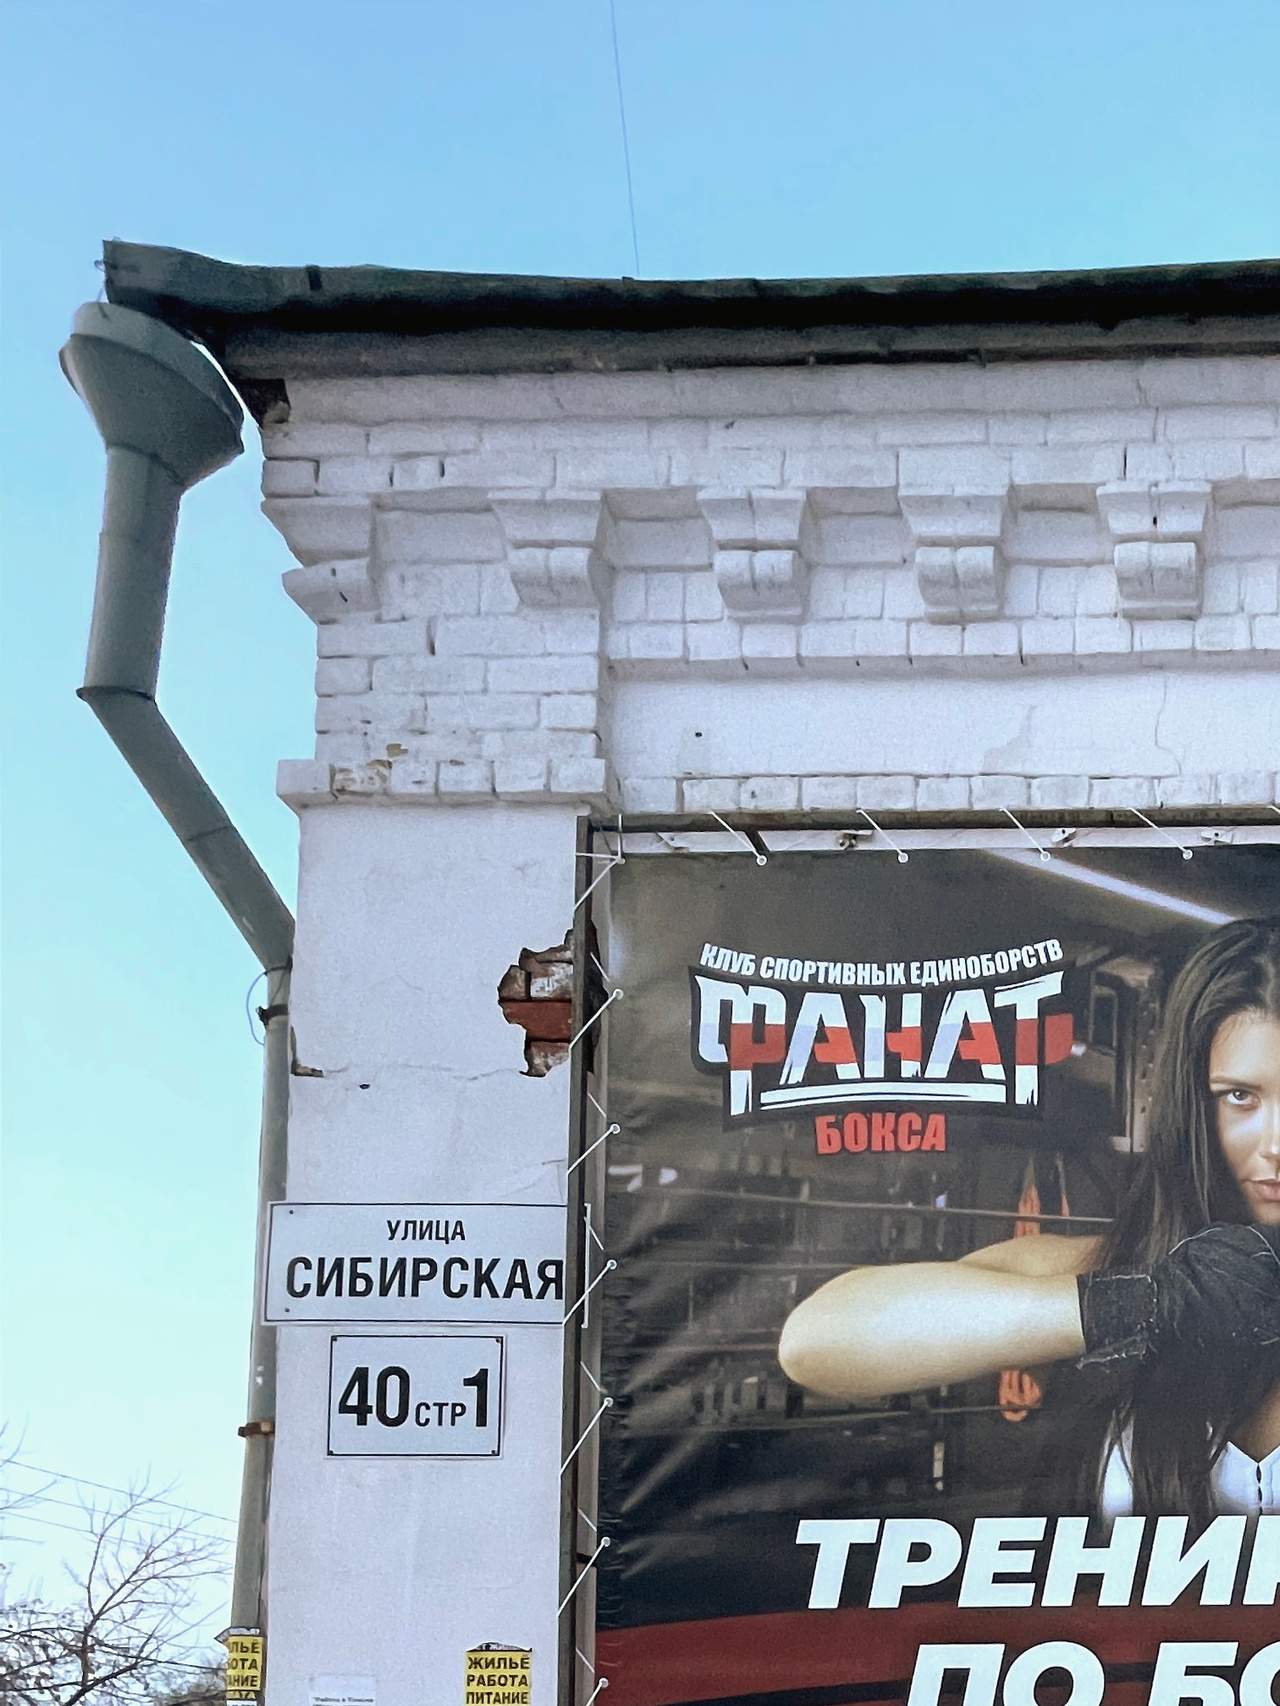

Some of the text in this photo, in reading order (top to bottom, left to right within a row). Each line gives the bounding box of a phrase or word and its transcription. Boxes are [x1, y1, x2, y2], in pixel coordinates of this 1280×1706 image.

[699, 938, 1064, 987] КЛУБ СПОРТИВНЫХ ЕДИНОБОРСТВ
[814, 1112, 947, 1154] БОКСА
[386, 1219, 466, 1244] УЛИЦА
[285, 1256, 564, 1300] СИБИРСКАЯ
[466, 1674, 528, 1687] РАБОТА
[466, 1692, 528, 1704] ПИТАНИЕ
